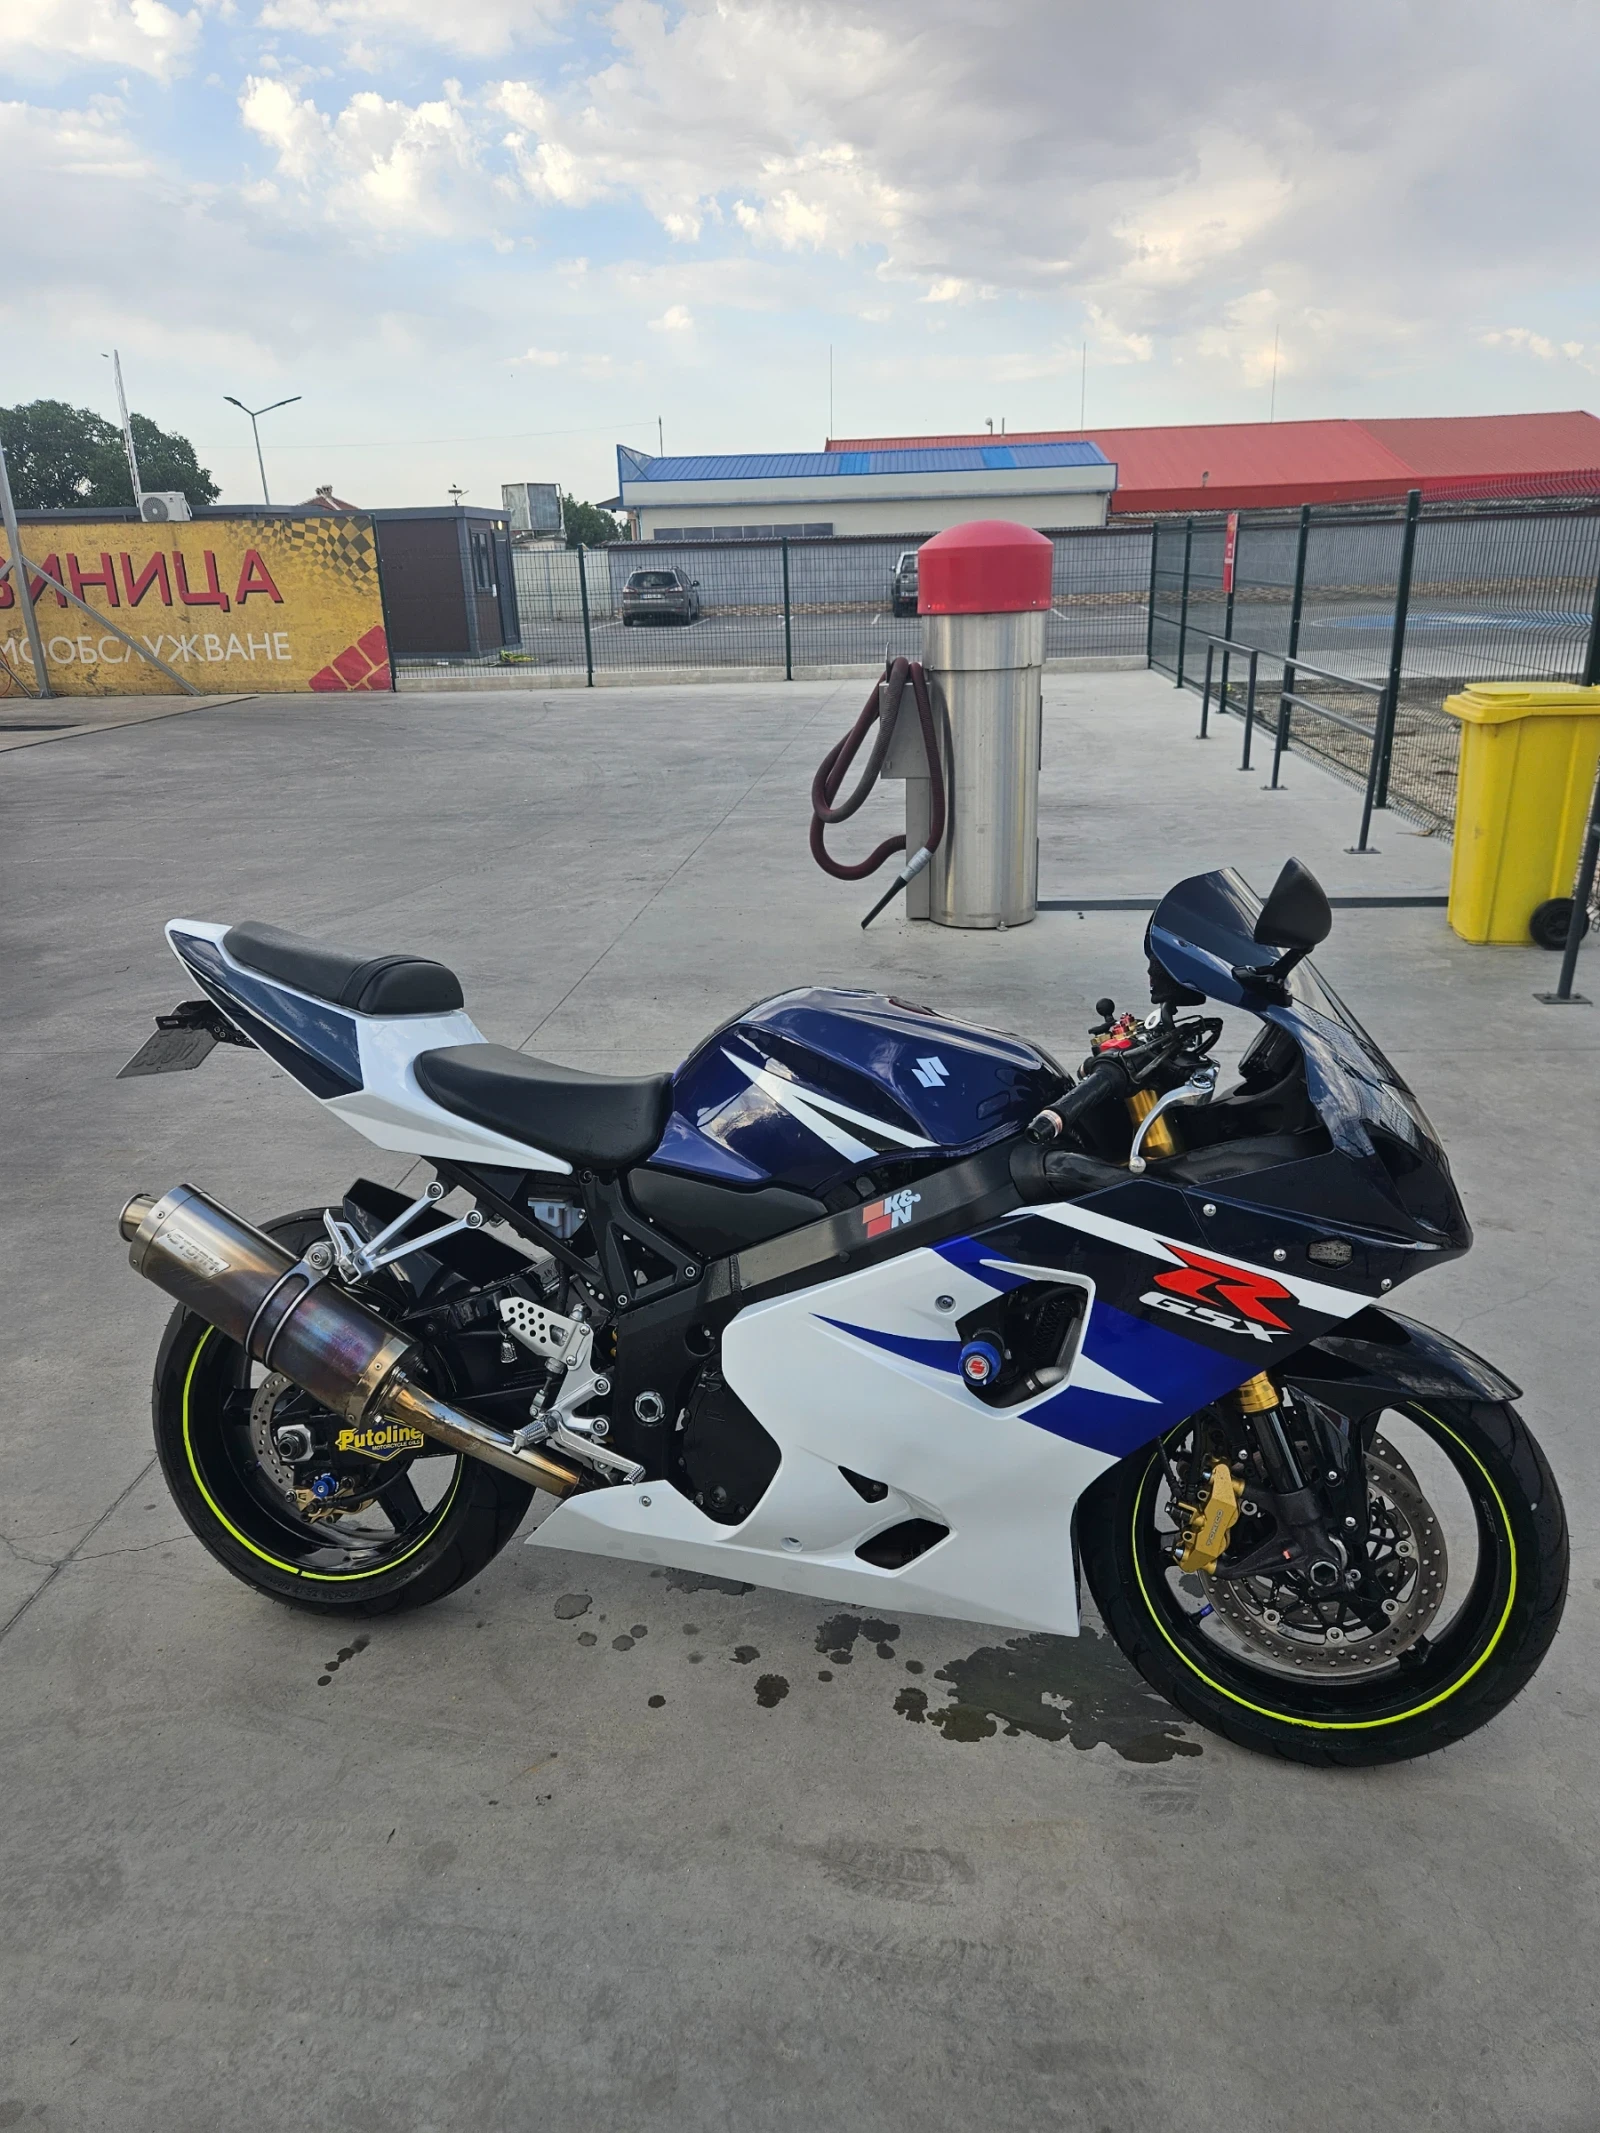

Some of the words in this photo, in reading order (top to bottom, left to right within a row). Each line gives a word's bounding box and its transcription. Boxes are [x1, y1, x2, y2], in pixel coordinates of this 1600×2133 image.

[339, 1425, 423, 1451] Putoline
[371, 1441, 407, 1451] MOTORCYCLE
[1206, 1509, 1223, 1546] TOKICO
